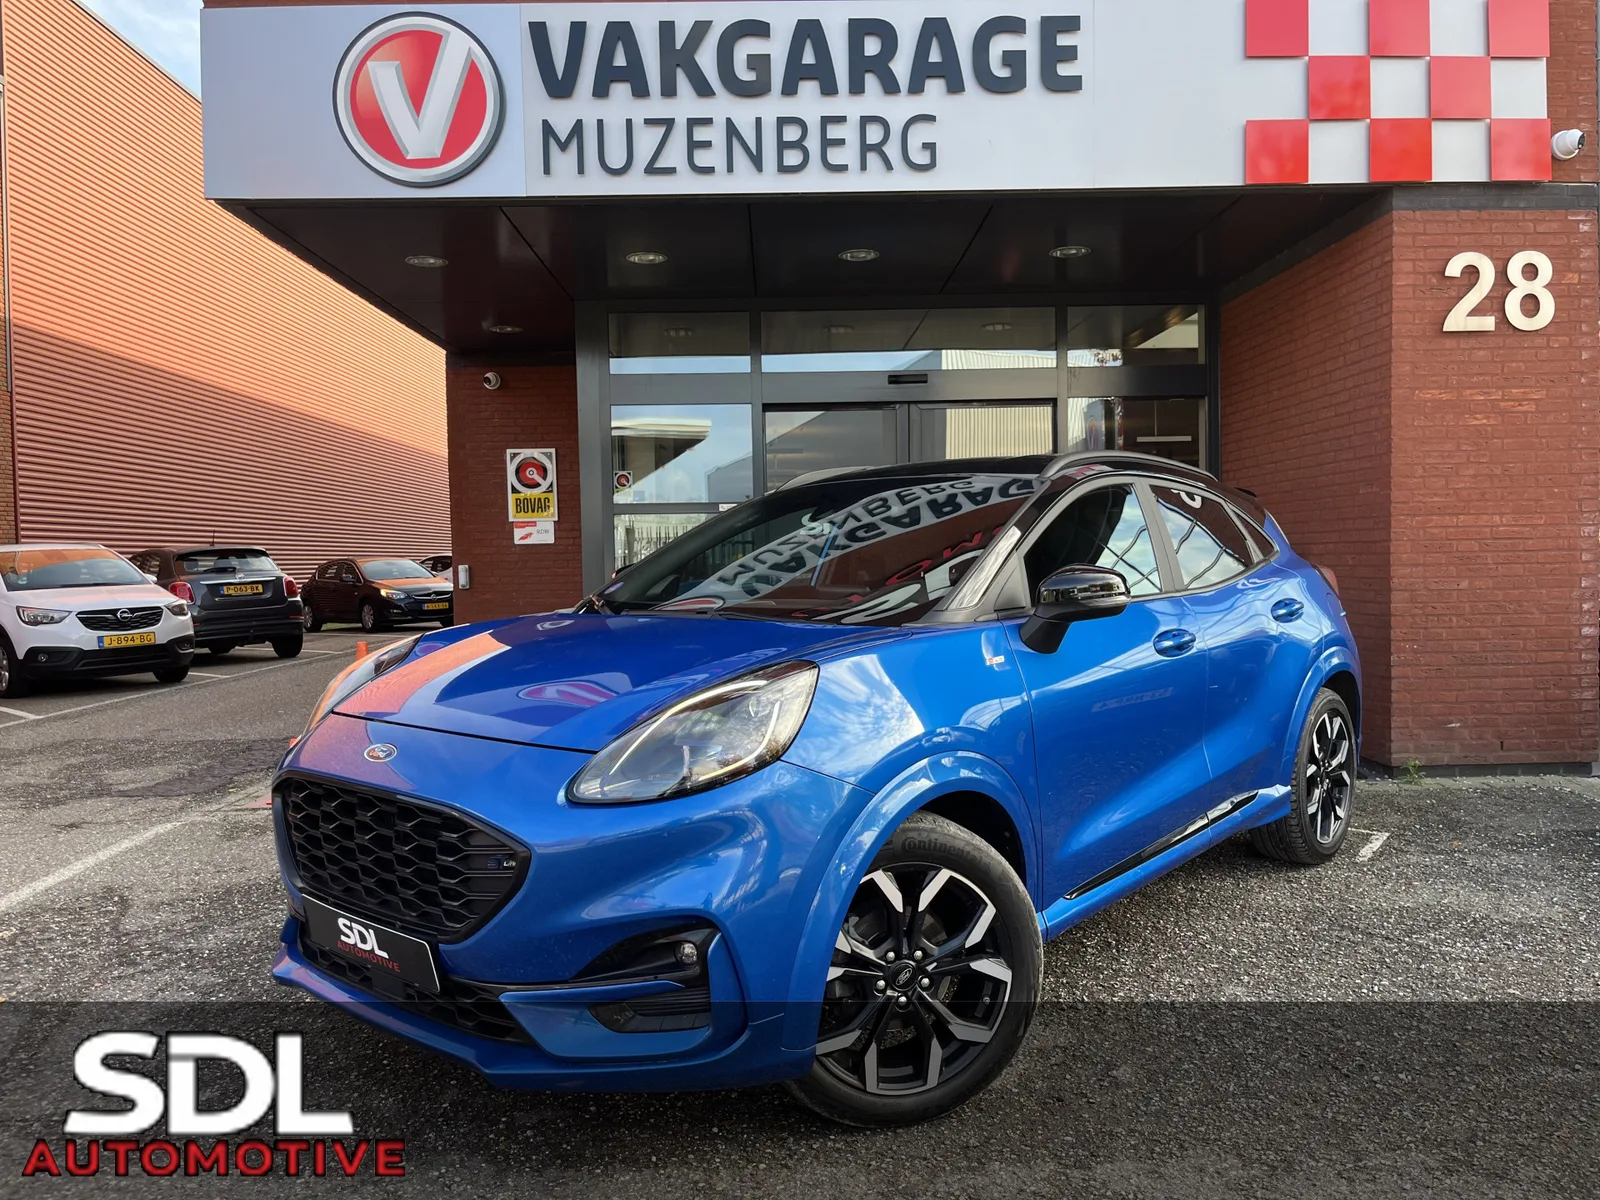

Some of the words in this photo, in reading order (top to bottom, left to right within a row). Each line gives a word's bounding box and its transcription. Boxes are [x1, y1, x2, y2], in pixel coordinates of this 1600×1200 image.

[528, 15, 1083, 99] VAKGARAGE
[541, 113, 938, 177] MUZENBERG
[1442, 250, 1556, 333] 28
[515, 497, 551, 514] BOVAG
[107, 633, 152, 646] J-894-BG
[337, 941, 400, 972] AUTOMOTIVE
[338, 917, 389, 959] SDL
